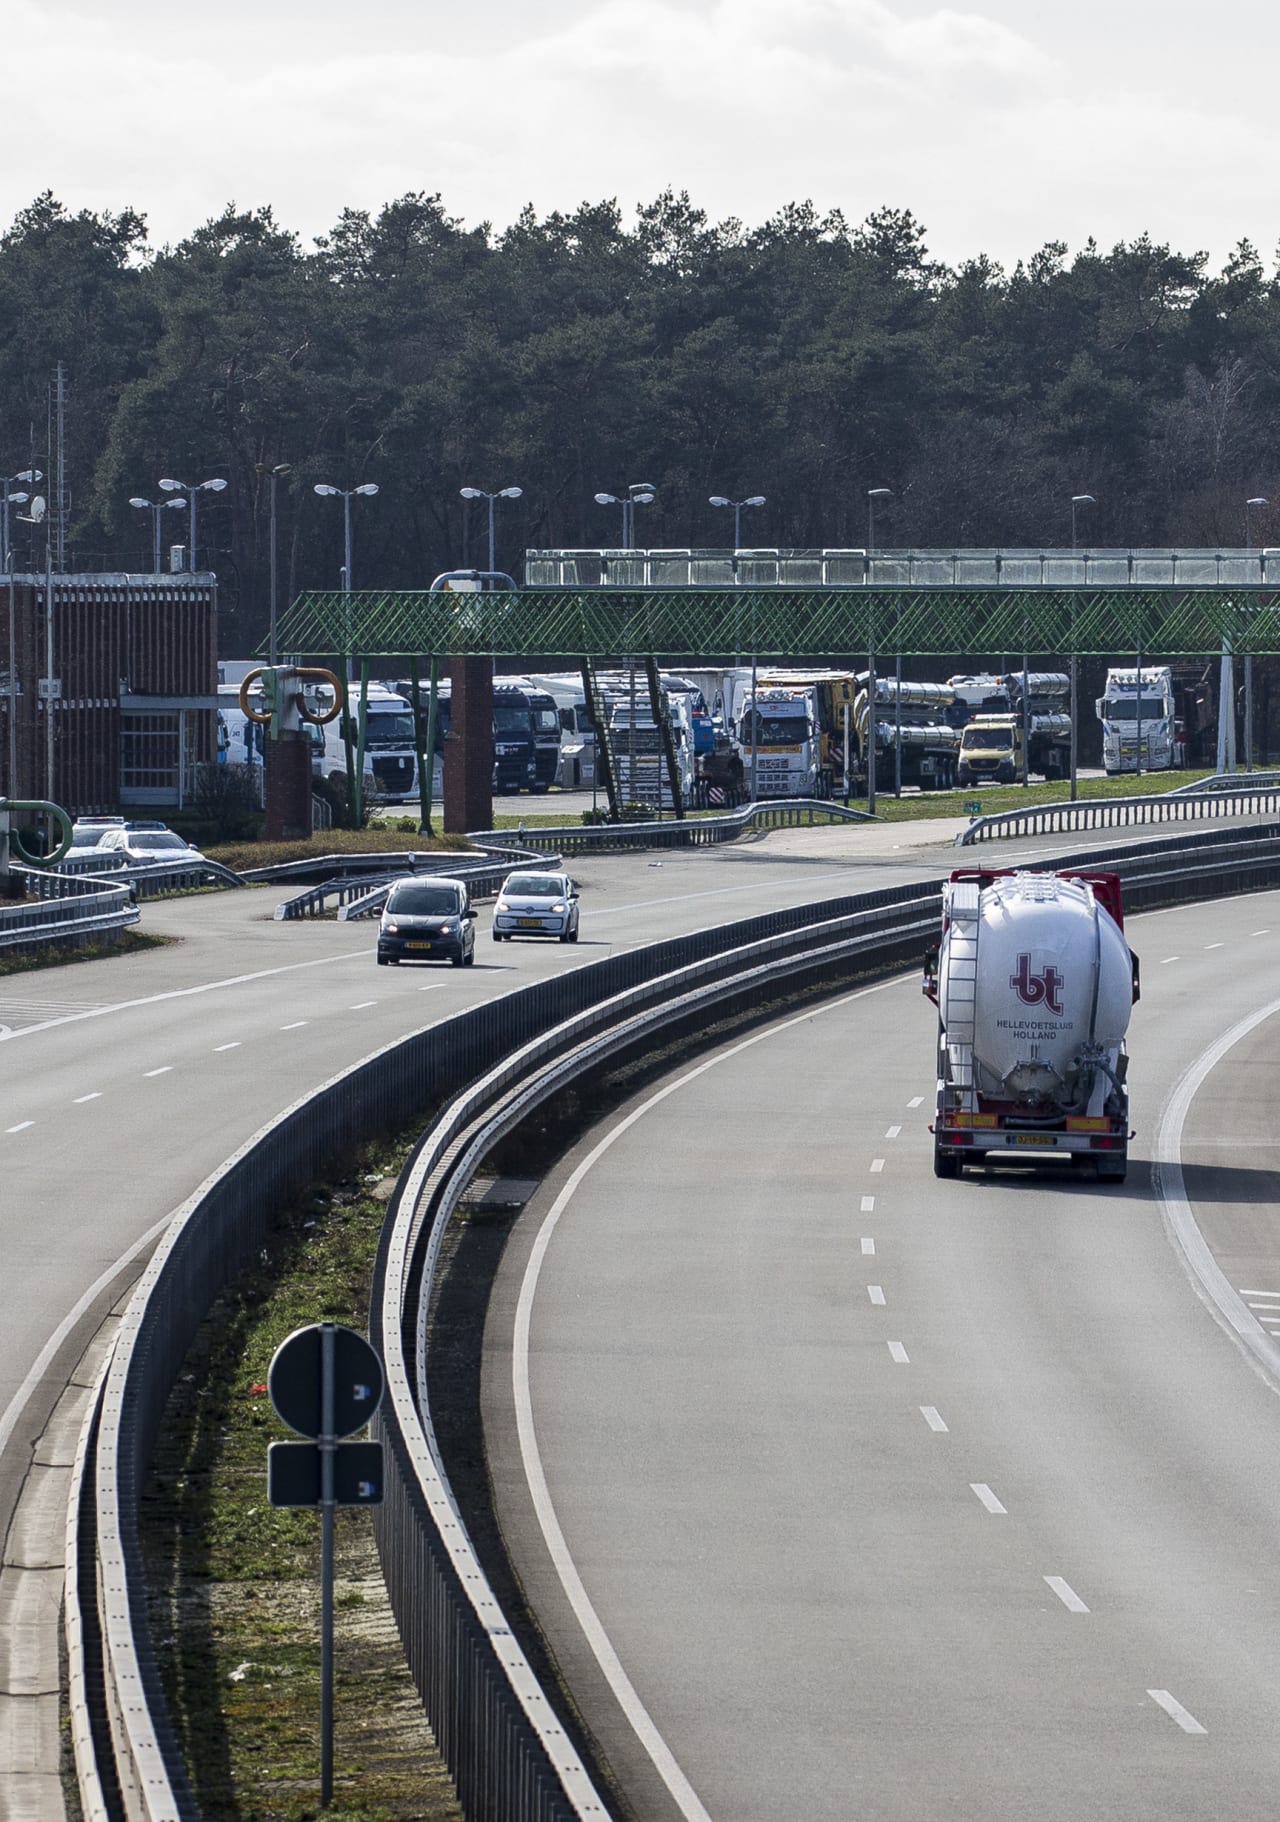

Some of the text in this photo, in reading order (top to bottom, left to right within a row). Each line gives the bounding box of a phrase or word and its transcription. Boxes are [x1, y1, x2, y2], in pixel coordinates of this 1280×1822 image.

[1009, 953, 1064, 1017] bt
[996, 1019, 1074, 1031] HELLEVOETSLUIS
[1013, 1030, 1057, 1040] HOLLAND
